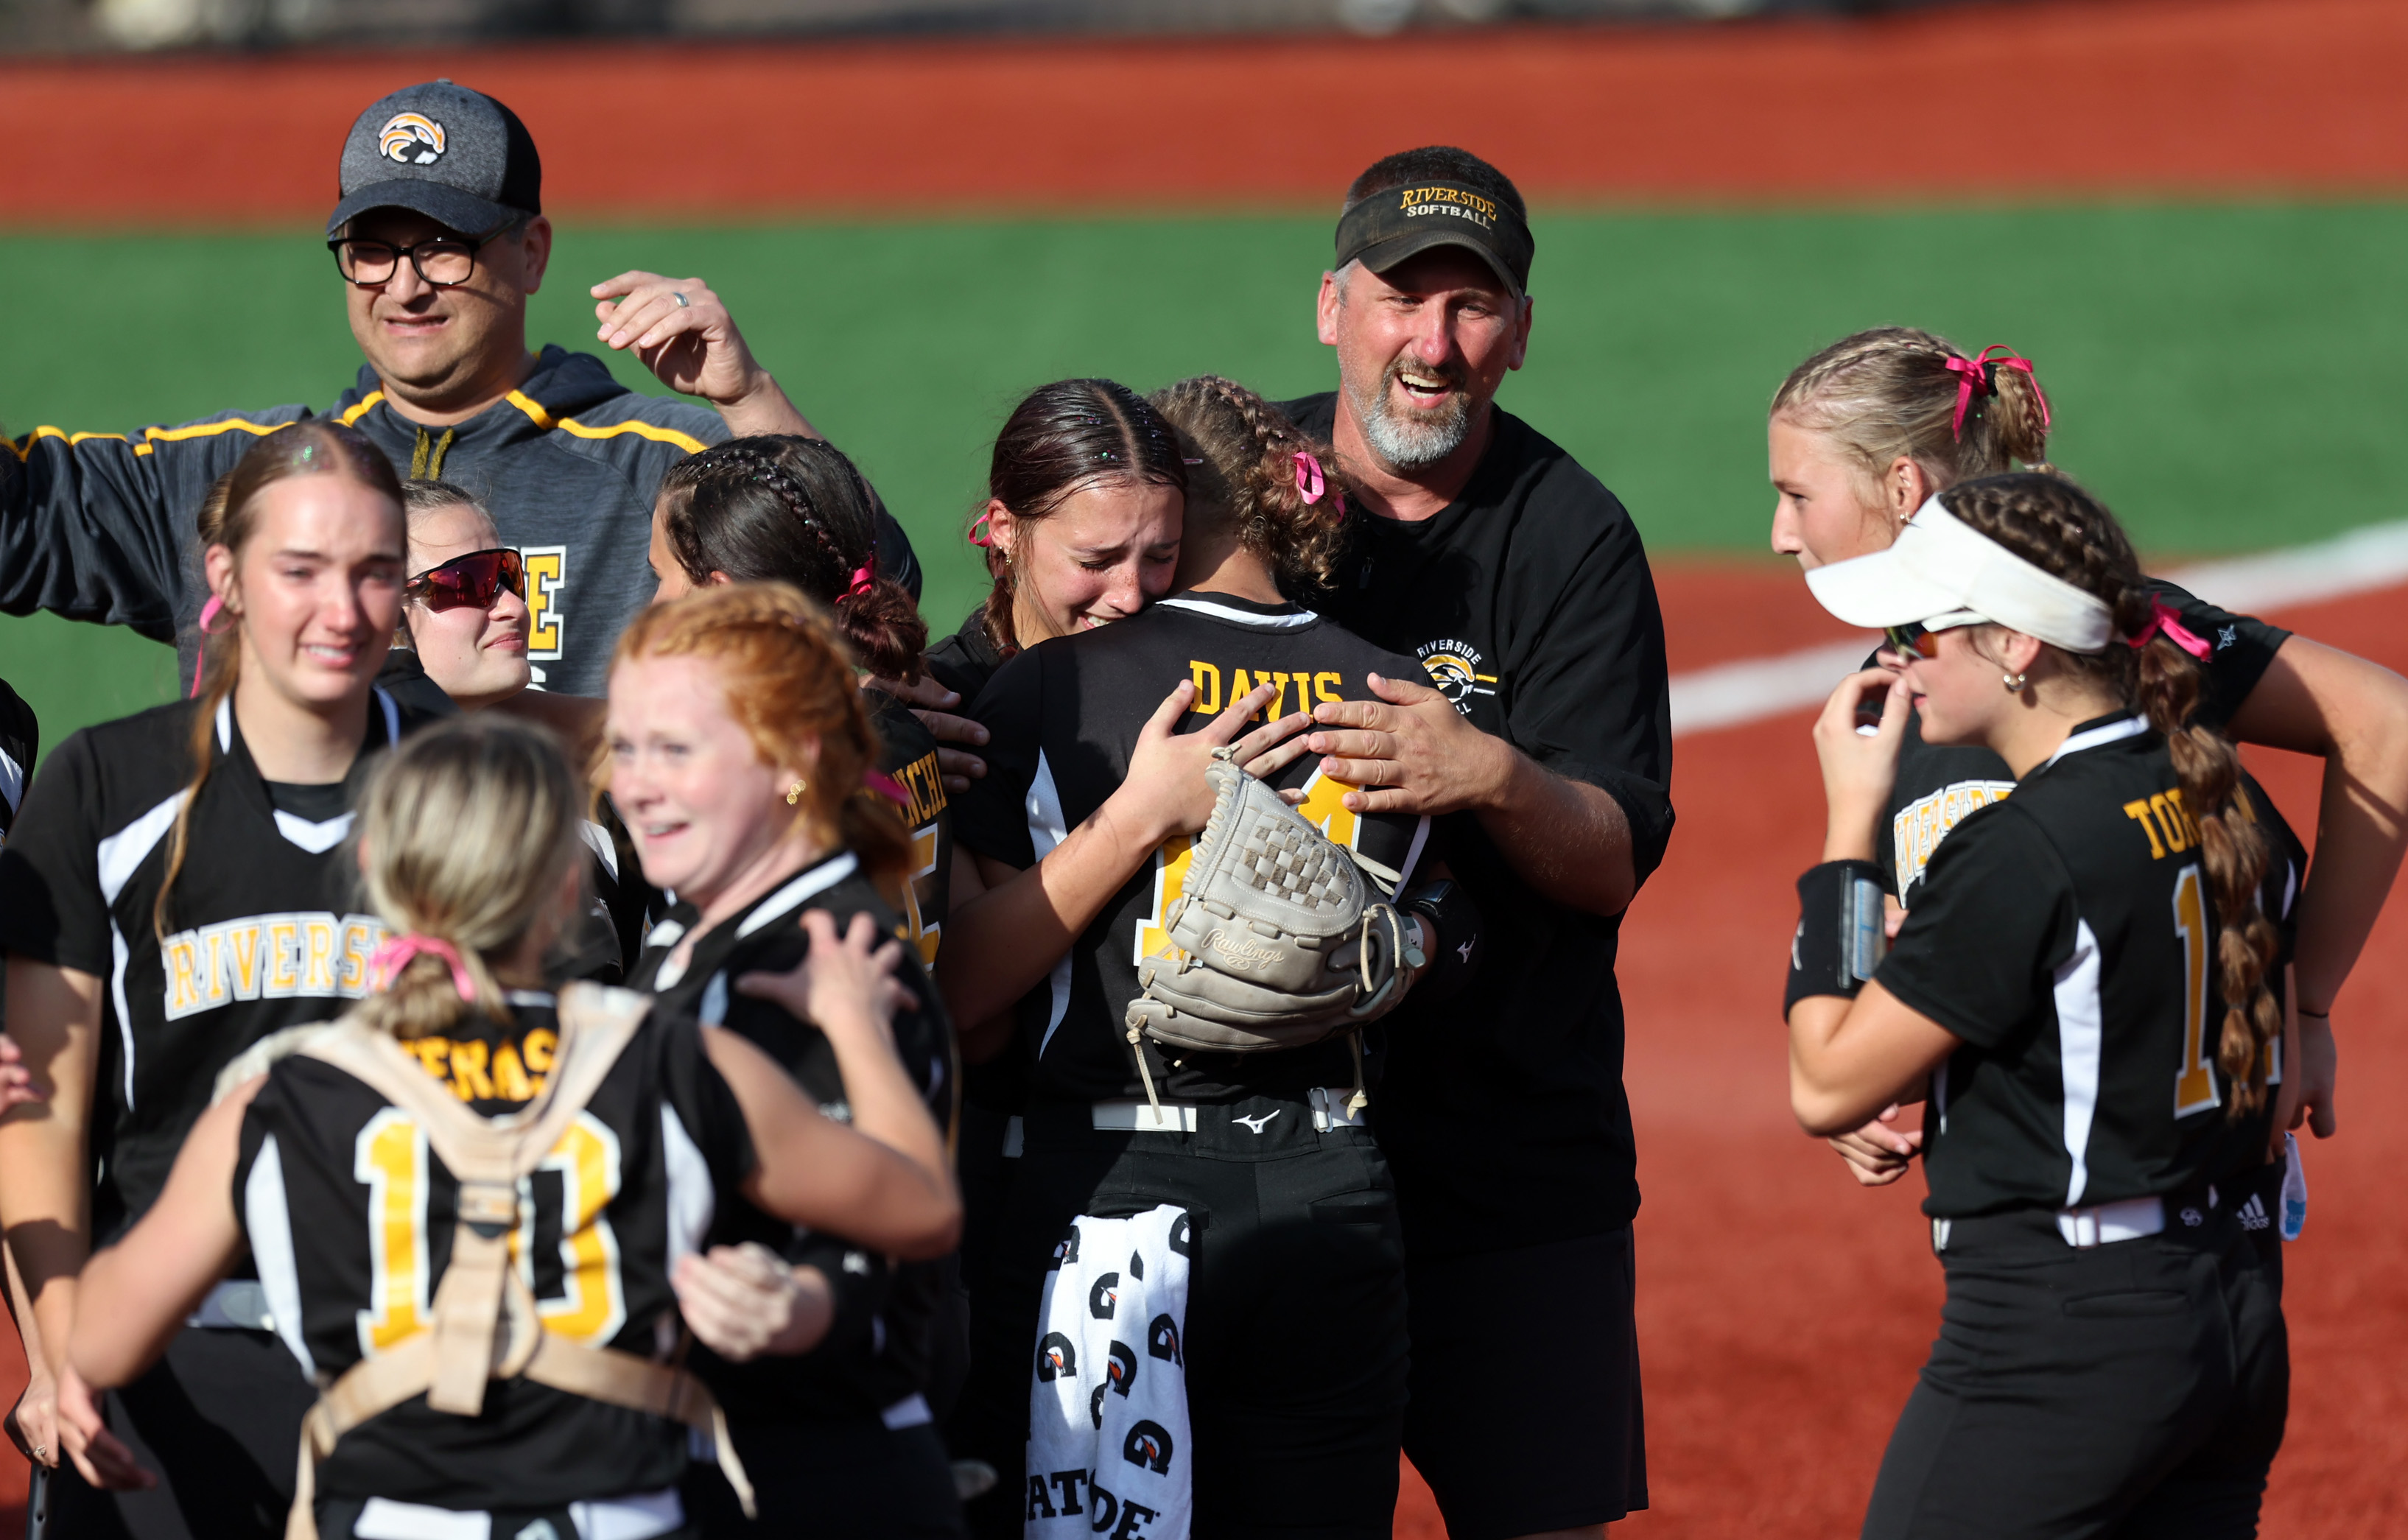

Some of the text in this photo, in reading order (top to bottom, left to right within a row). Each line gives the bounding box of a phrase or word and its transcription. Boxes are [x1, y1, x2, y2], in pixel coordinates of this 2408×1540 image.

[1400, 186, 1497, 222] RIVERSIDE
[1407, 204, 1491, 230] SOFTBALL
[1417, 639, 1482, 665] RIVERSIDE
[1190, 660, 1344, 724] DAVIS
[1201, 928, 1285, 970] Rawlings
